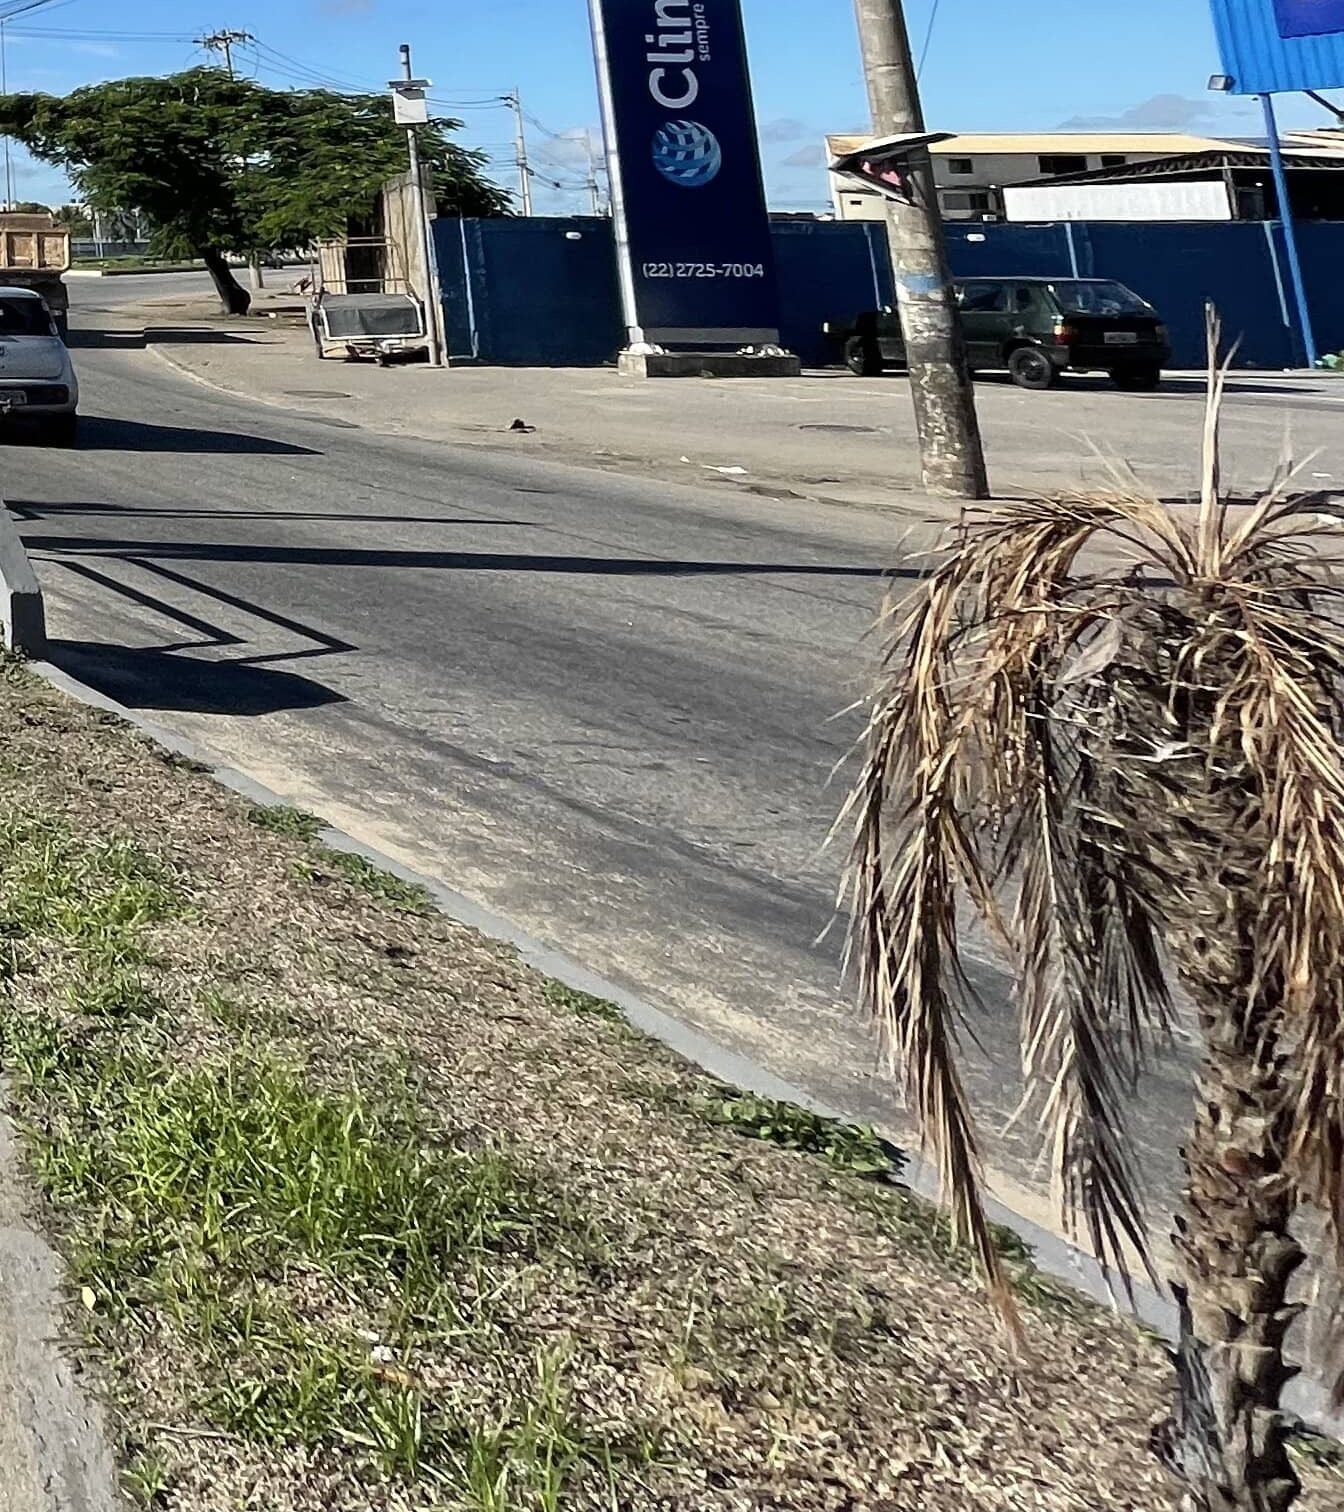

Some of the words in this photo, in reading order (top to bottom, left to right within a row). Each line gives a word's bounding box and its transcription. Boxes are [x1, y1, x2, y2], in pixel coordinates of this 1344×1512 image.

[692, 3, 712, 63] sempre
[642, 263, 674, 278] (22)
[676, 263, 765, 278] 2725-7004
